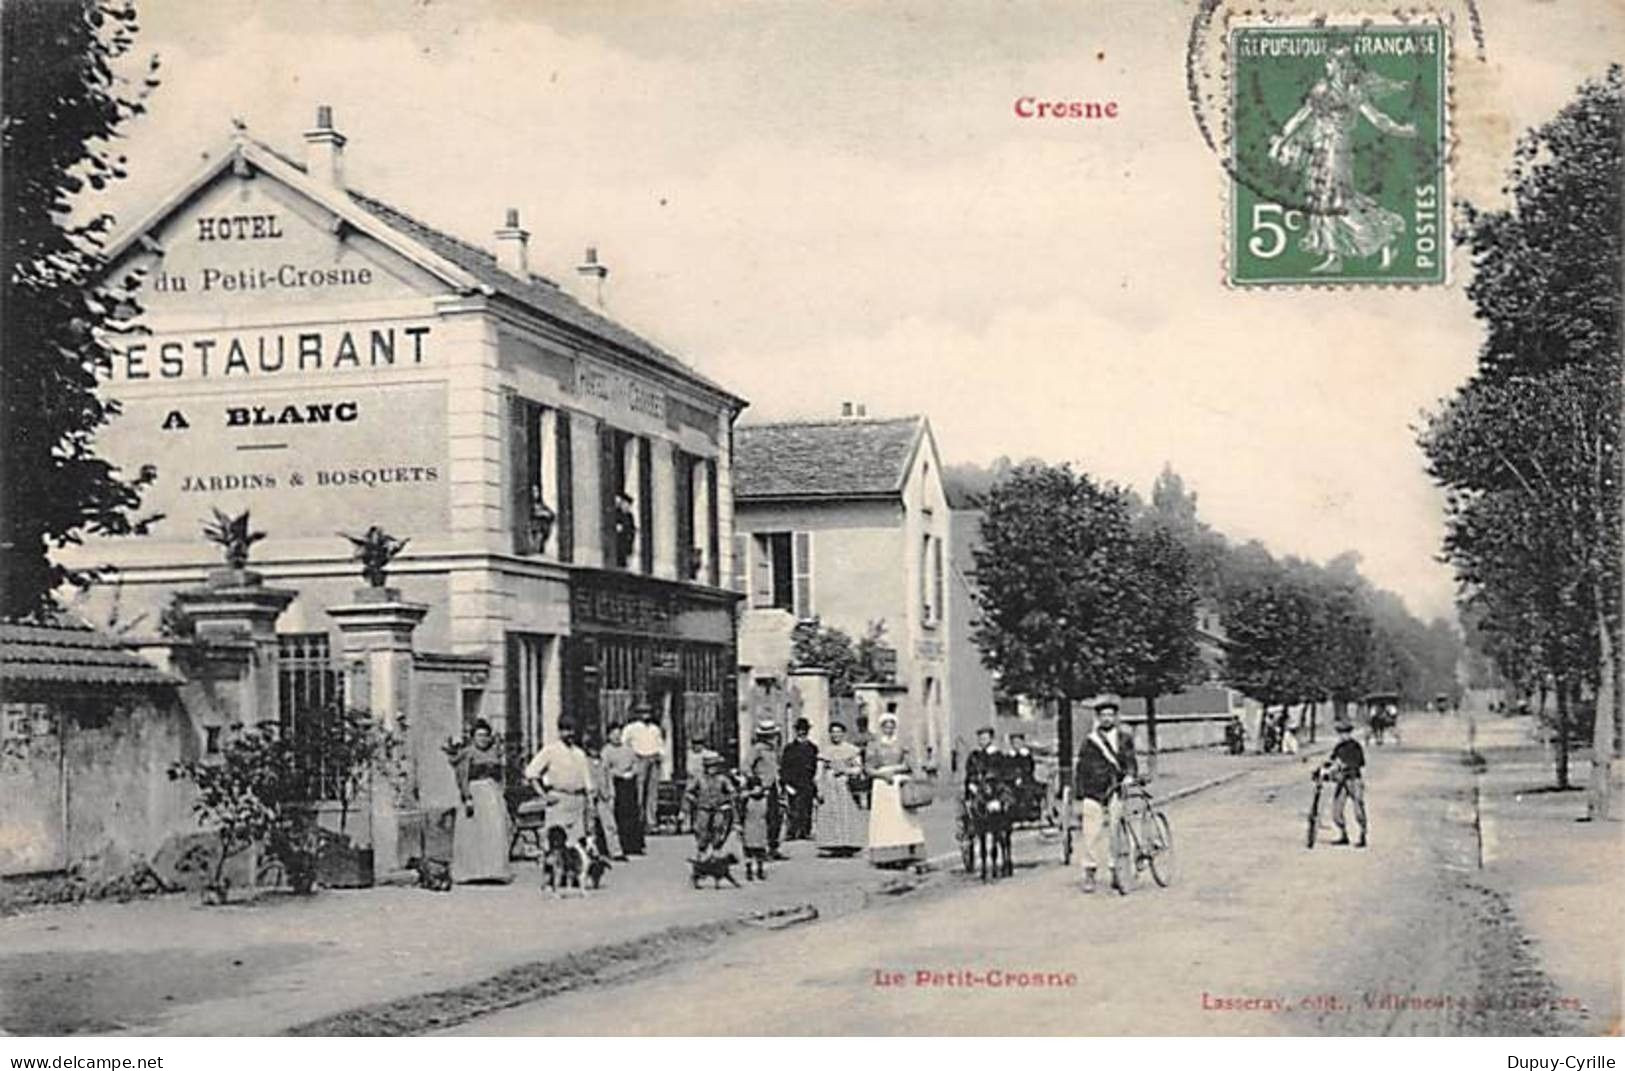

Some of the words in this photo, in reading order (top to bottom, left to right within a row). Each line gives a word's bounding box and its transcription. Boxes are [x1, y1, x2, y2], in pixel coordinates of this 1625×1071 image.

[199, 215, 283, 241] HOTEL
[1416, 184, 1436, 268] POSTES
[154, 273, 187, 293] du
[202, 265, 373, 292] Petit-Crosne
[162, 411, 189, 430] A
[226, 402, 358, 427] BLANC
[181, 475, 277, 491] JARDINS
[289, 474, 304, 486] &
[317, 467, 439, 486] BOSQUETS
